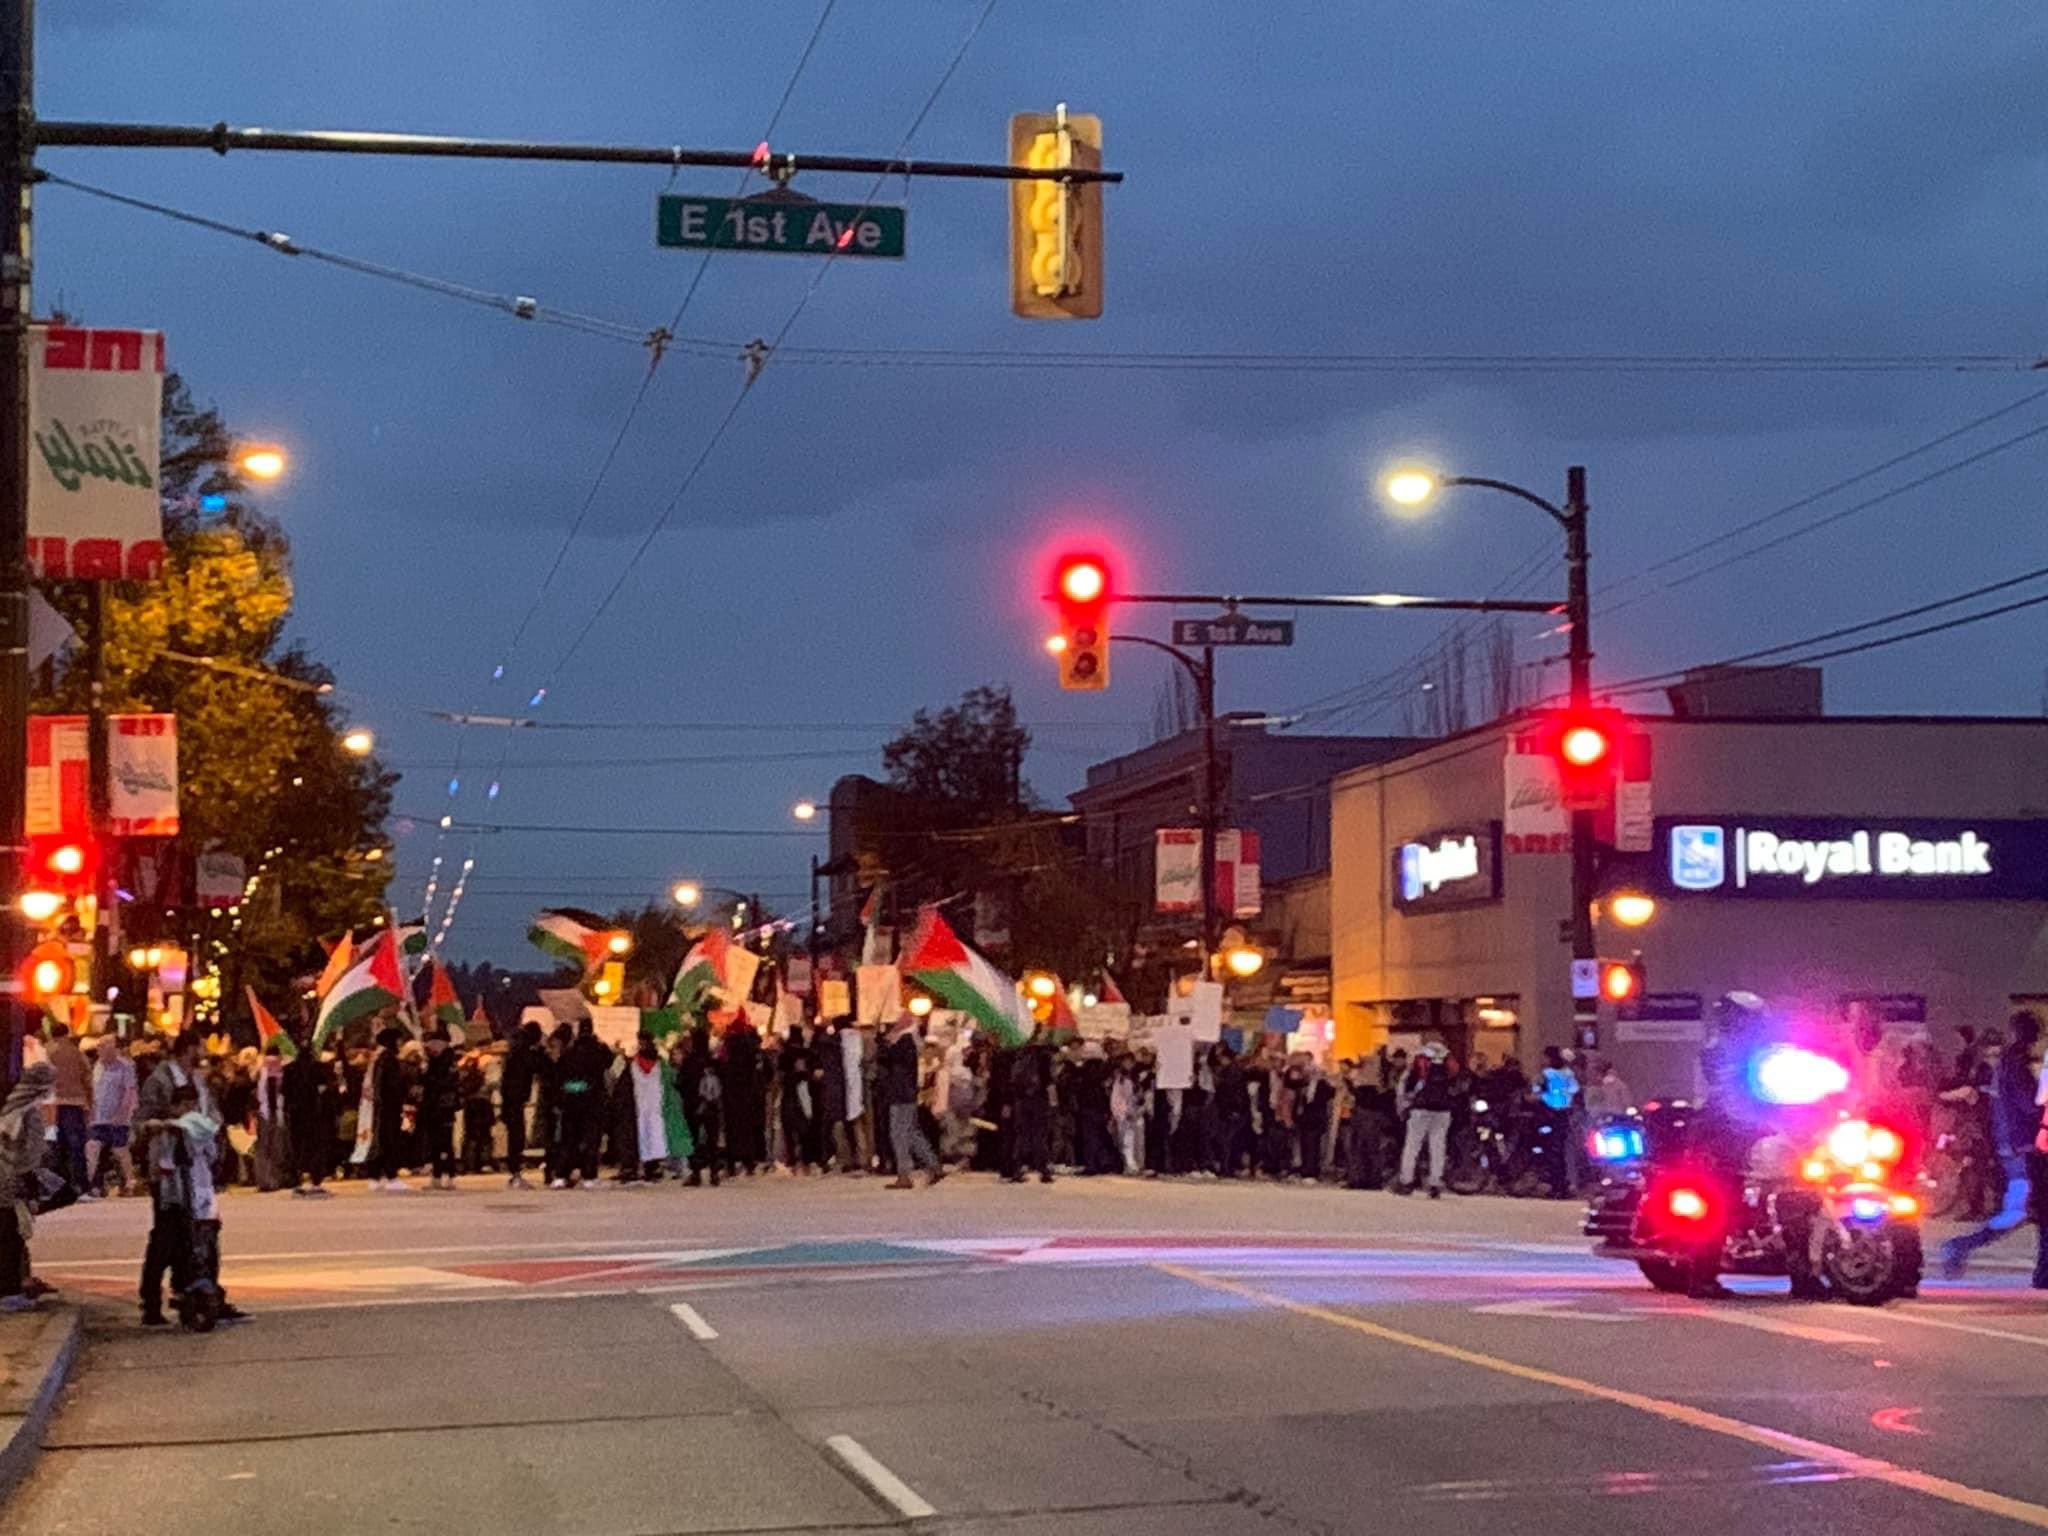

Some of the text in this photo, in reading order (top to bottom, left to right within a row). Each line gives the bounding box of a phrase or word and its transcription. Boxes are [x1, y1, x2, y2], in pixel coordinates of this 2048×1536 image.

[680, 203, 882, 248] E 1st Ave
[1182, 622, 1283, 642] E 1st Ave
[1747, 829, 1993, 884] Royal Bank
